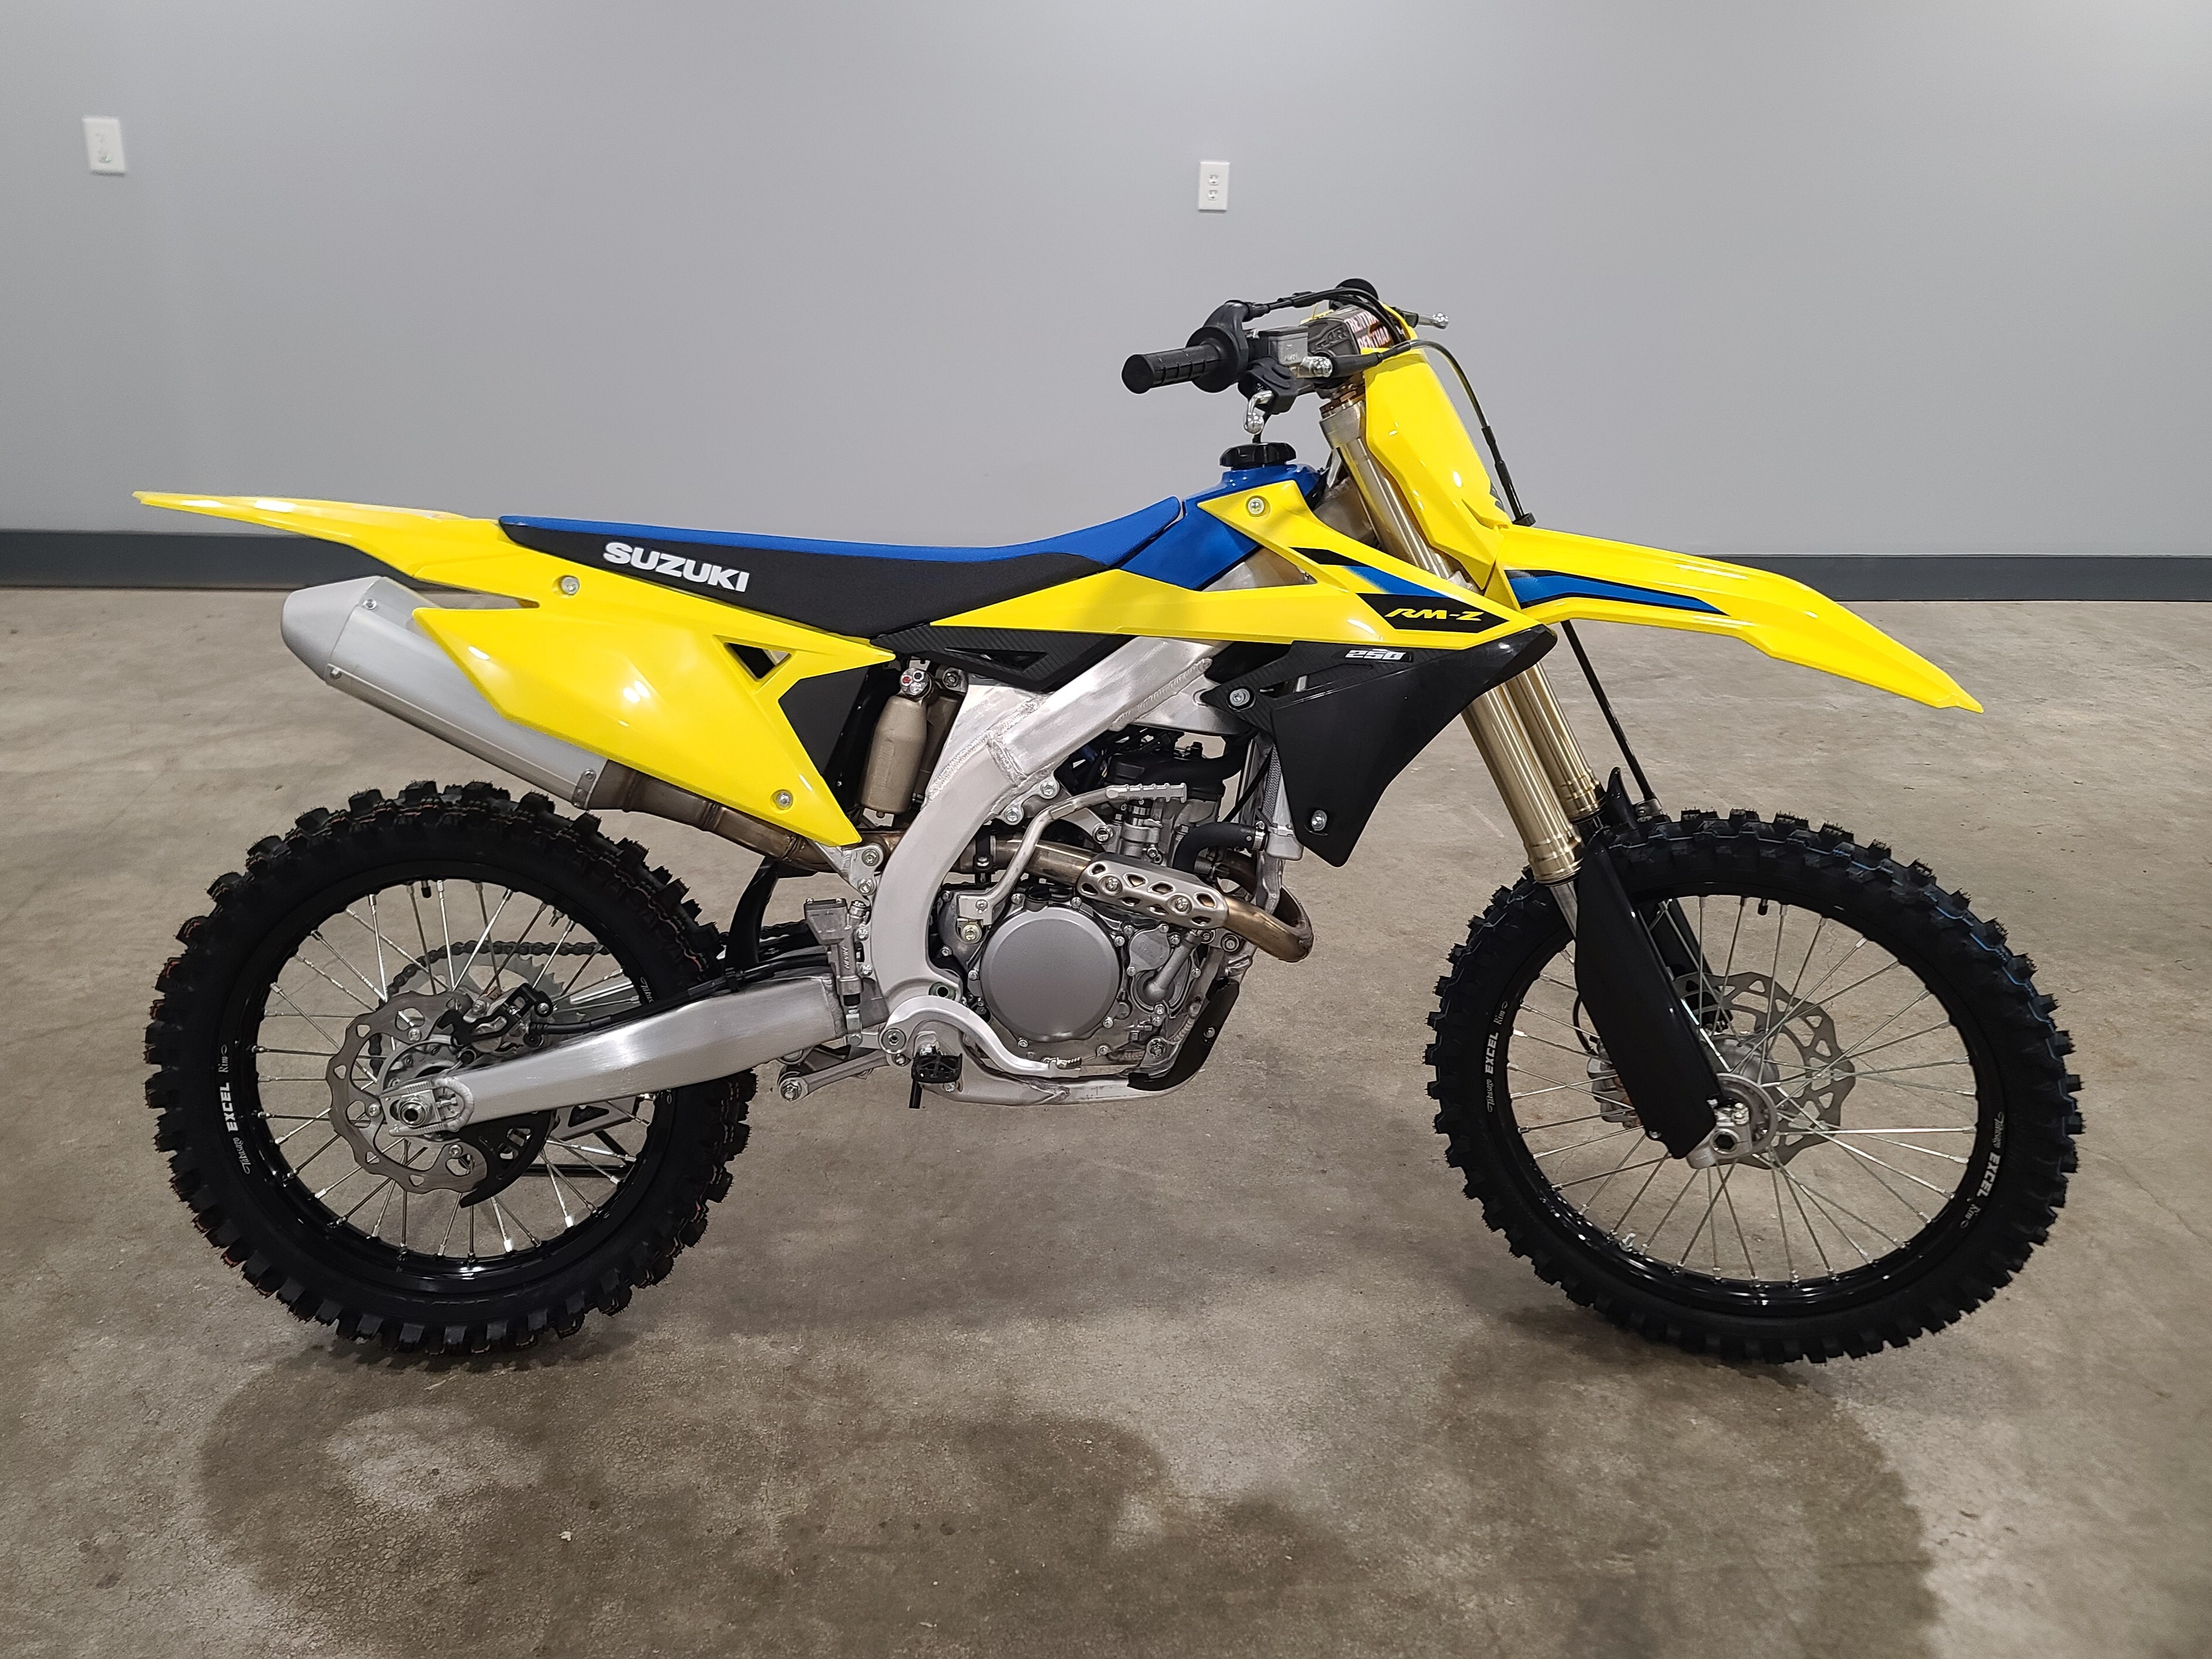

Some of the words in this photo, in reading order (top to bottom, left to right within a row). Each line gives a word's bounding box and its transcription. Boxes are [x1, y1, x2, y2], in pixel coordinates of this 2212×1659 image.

[1345, 311, 1379, 333] RENTHA
[603, 542, 749, 592] SUZUKI
[1385, 608, 1484, 621] RM-Z
[1345, 649, 1406, 660] 250
[640, 977, 654, 1003] Takas
[1485, 1031, 1499, 1075] EXCEL
[1494, 1001, 1508, 1025] Rim
[219, 1044, 229, 1073] Rim
[220, 1082, 238, 1132] EXCEL
[233, 1137, 251, 1174] Takasago
[1976, 1152, 2001, 1197] EXCEL
